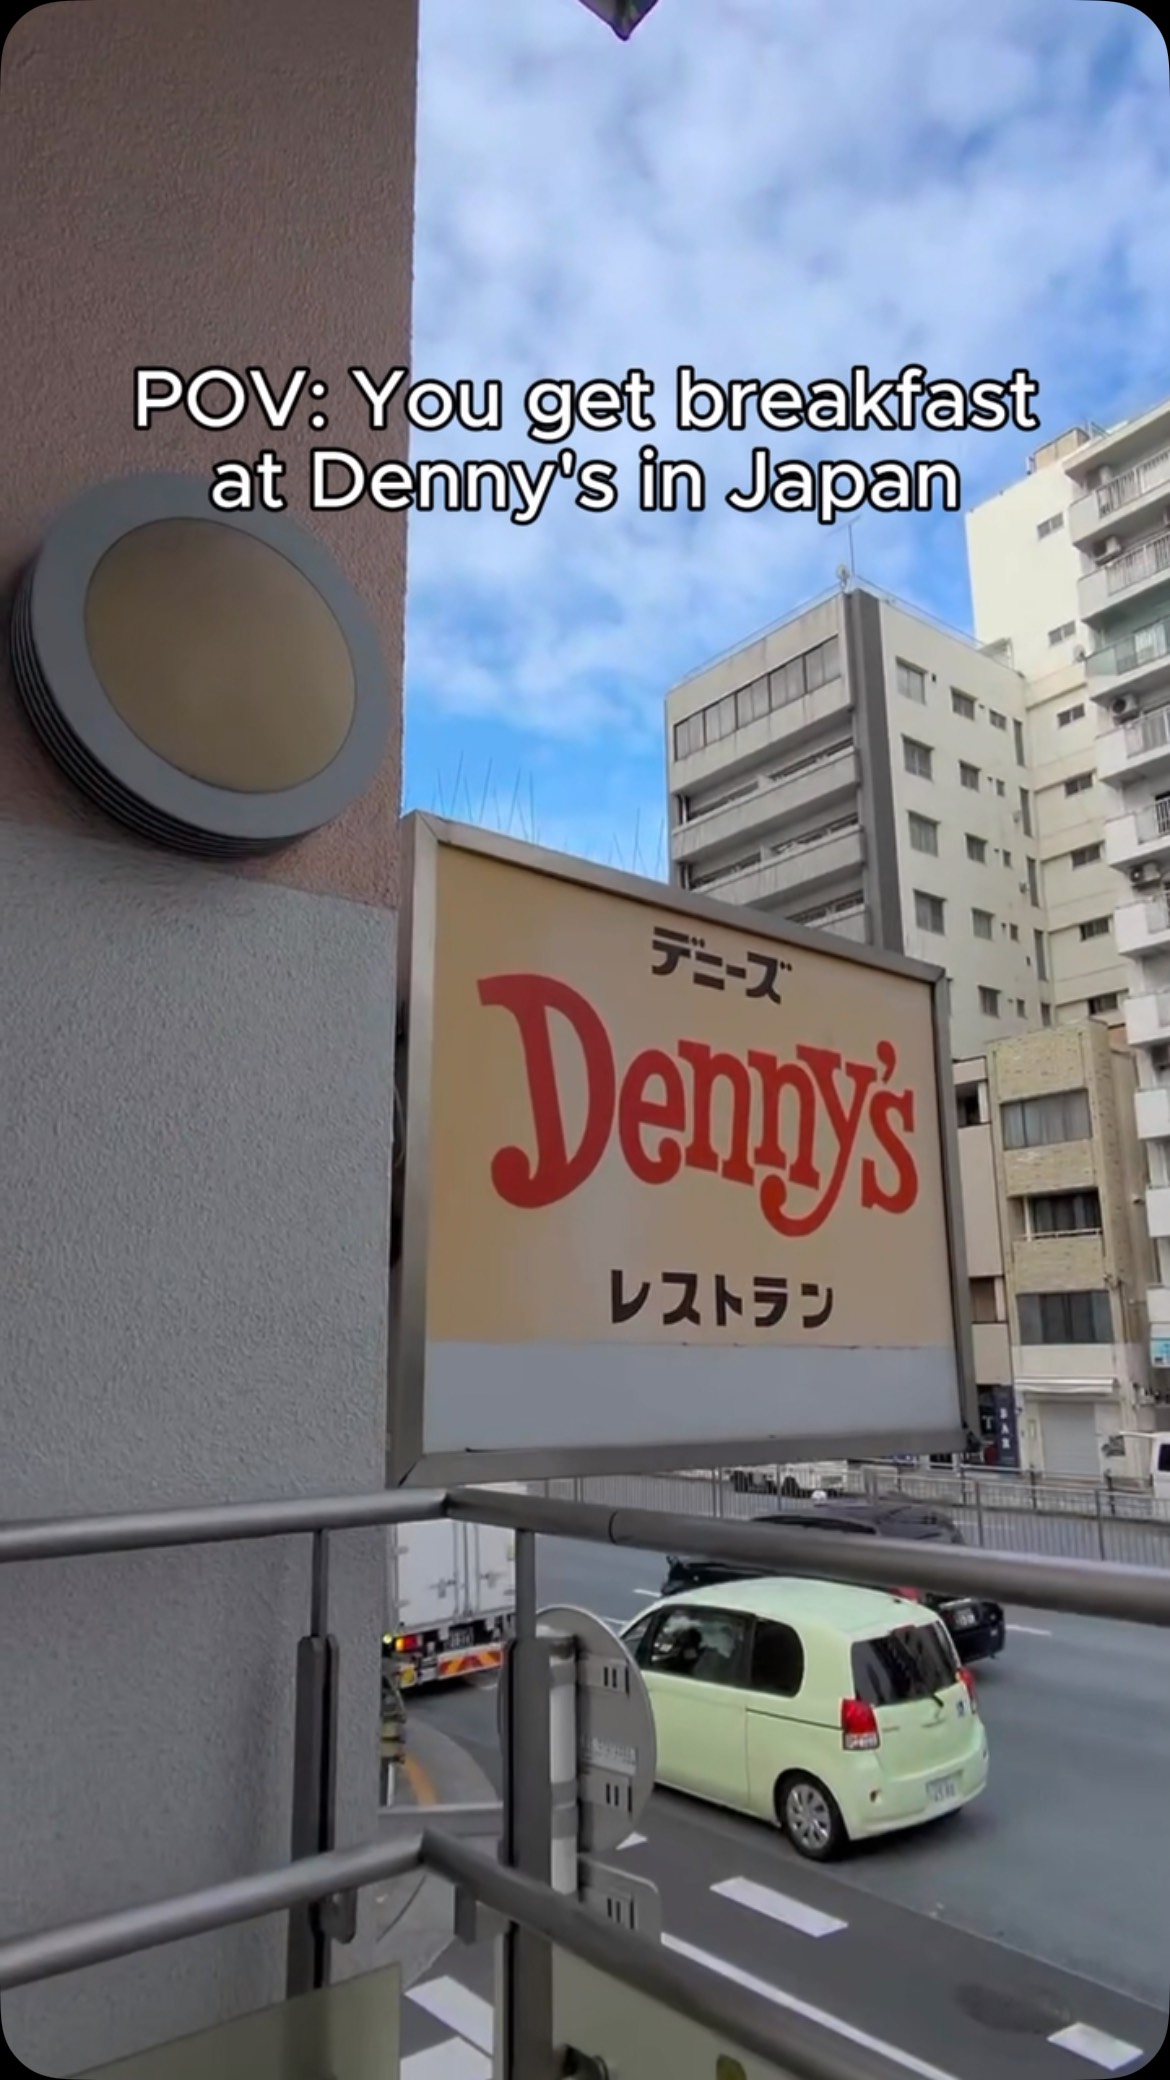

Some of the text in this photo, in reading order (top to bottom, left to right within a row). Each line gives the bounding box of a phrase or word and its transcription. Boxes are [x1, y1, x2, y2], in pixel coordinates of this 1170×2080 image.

[651, 925, 793, 1005] デニーズ
[476, 972, 919, 1238] Denny's
[610, 1268, 834, 1329] レストラン
